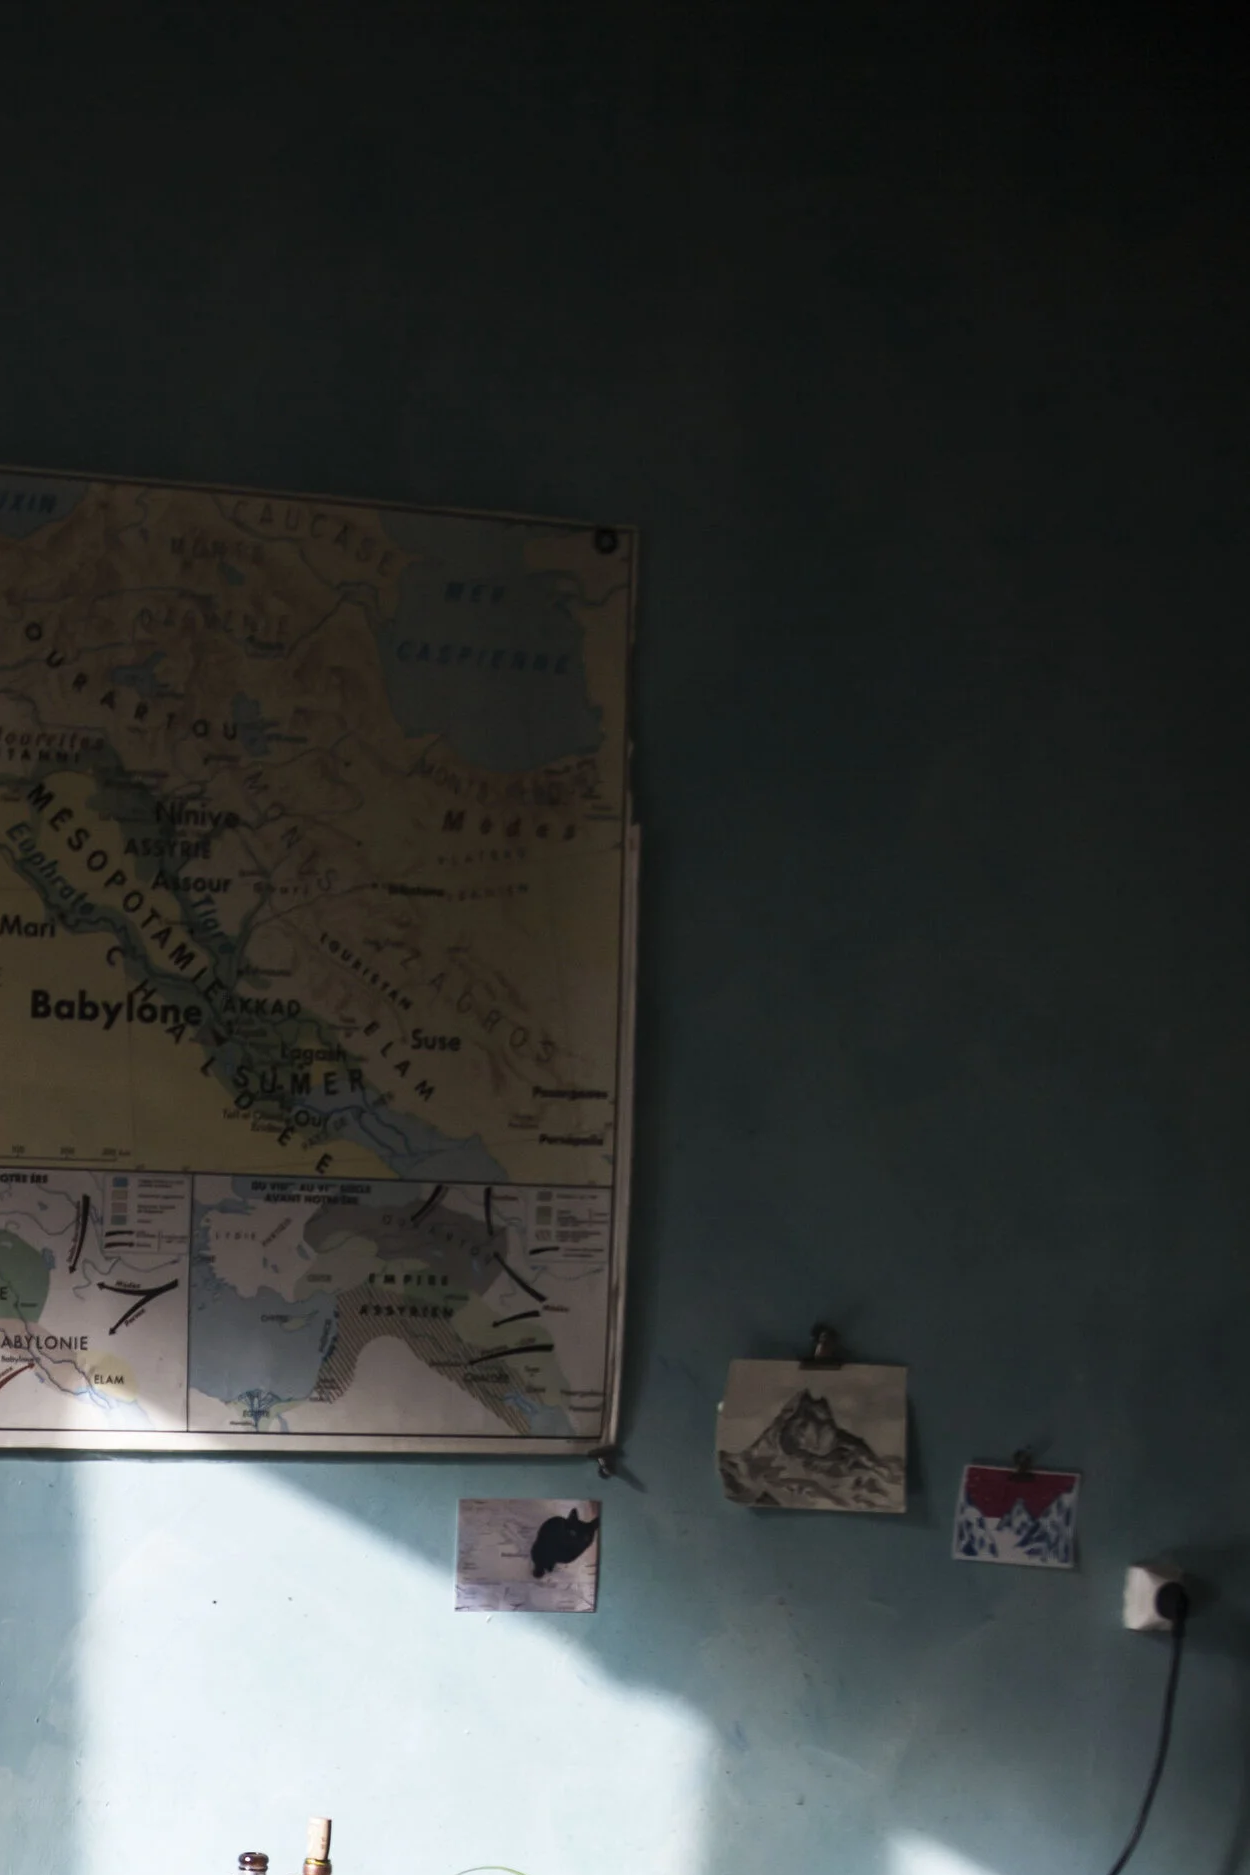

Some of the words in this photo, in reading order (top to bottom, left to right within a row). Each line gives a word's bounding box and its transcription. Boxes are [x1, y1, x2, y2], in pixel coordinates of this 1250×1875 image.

[124, 837, 212, 859] ASSYRIE
[151, 867, 233, 893] Assour
[0, 914, 56, 938] Mari
[29, 989, 203, 1031] Babylone
[222, 997, 301, 1018] AKKAD
[411, 1028, 462, 1052] Suse
[232, 1062, 365, 1096] SUMER
[94, 1373, 125, 1386] ELAM
